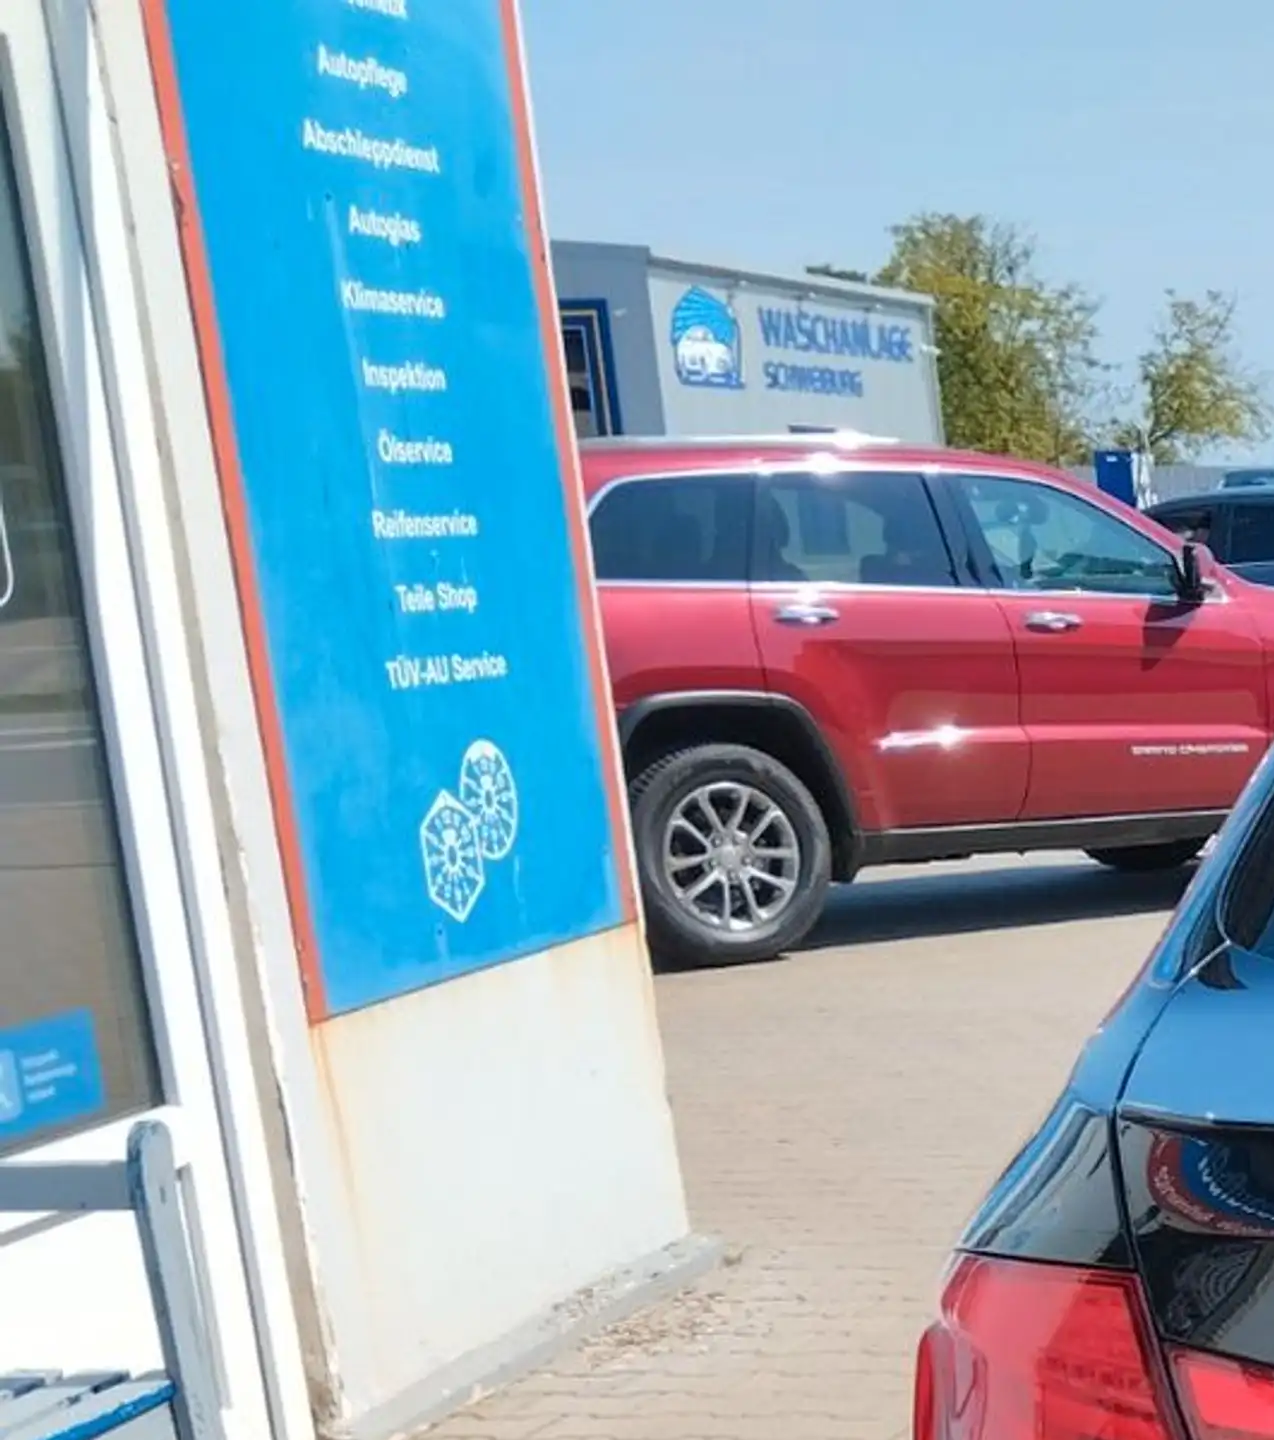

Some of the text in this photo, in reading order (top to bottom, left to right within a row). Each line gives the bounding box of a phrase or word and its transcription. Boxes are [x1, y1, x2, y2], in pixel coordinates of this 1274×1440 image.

[317, 41, 408, 98] Autopflege
[302, 117, 441, 174] Abschleppdienst
[348, 203, 421, 247] Autoglas
[339, 278, 446, 319] Klimaservice
[757, 304, 914, 364] WASCHANLAGE
[361, 356, 448, 396] Inspektion
[377, 427, 453, 465] Ölservice
[371, 507, 479, 540] Reifenservice
[395, 581, 479, 614] Teile Shop
[385, 650, 508, 691] TÜV-AU Service
